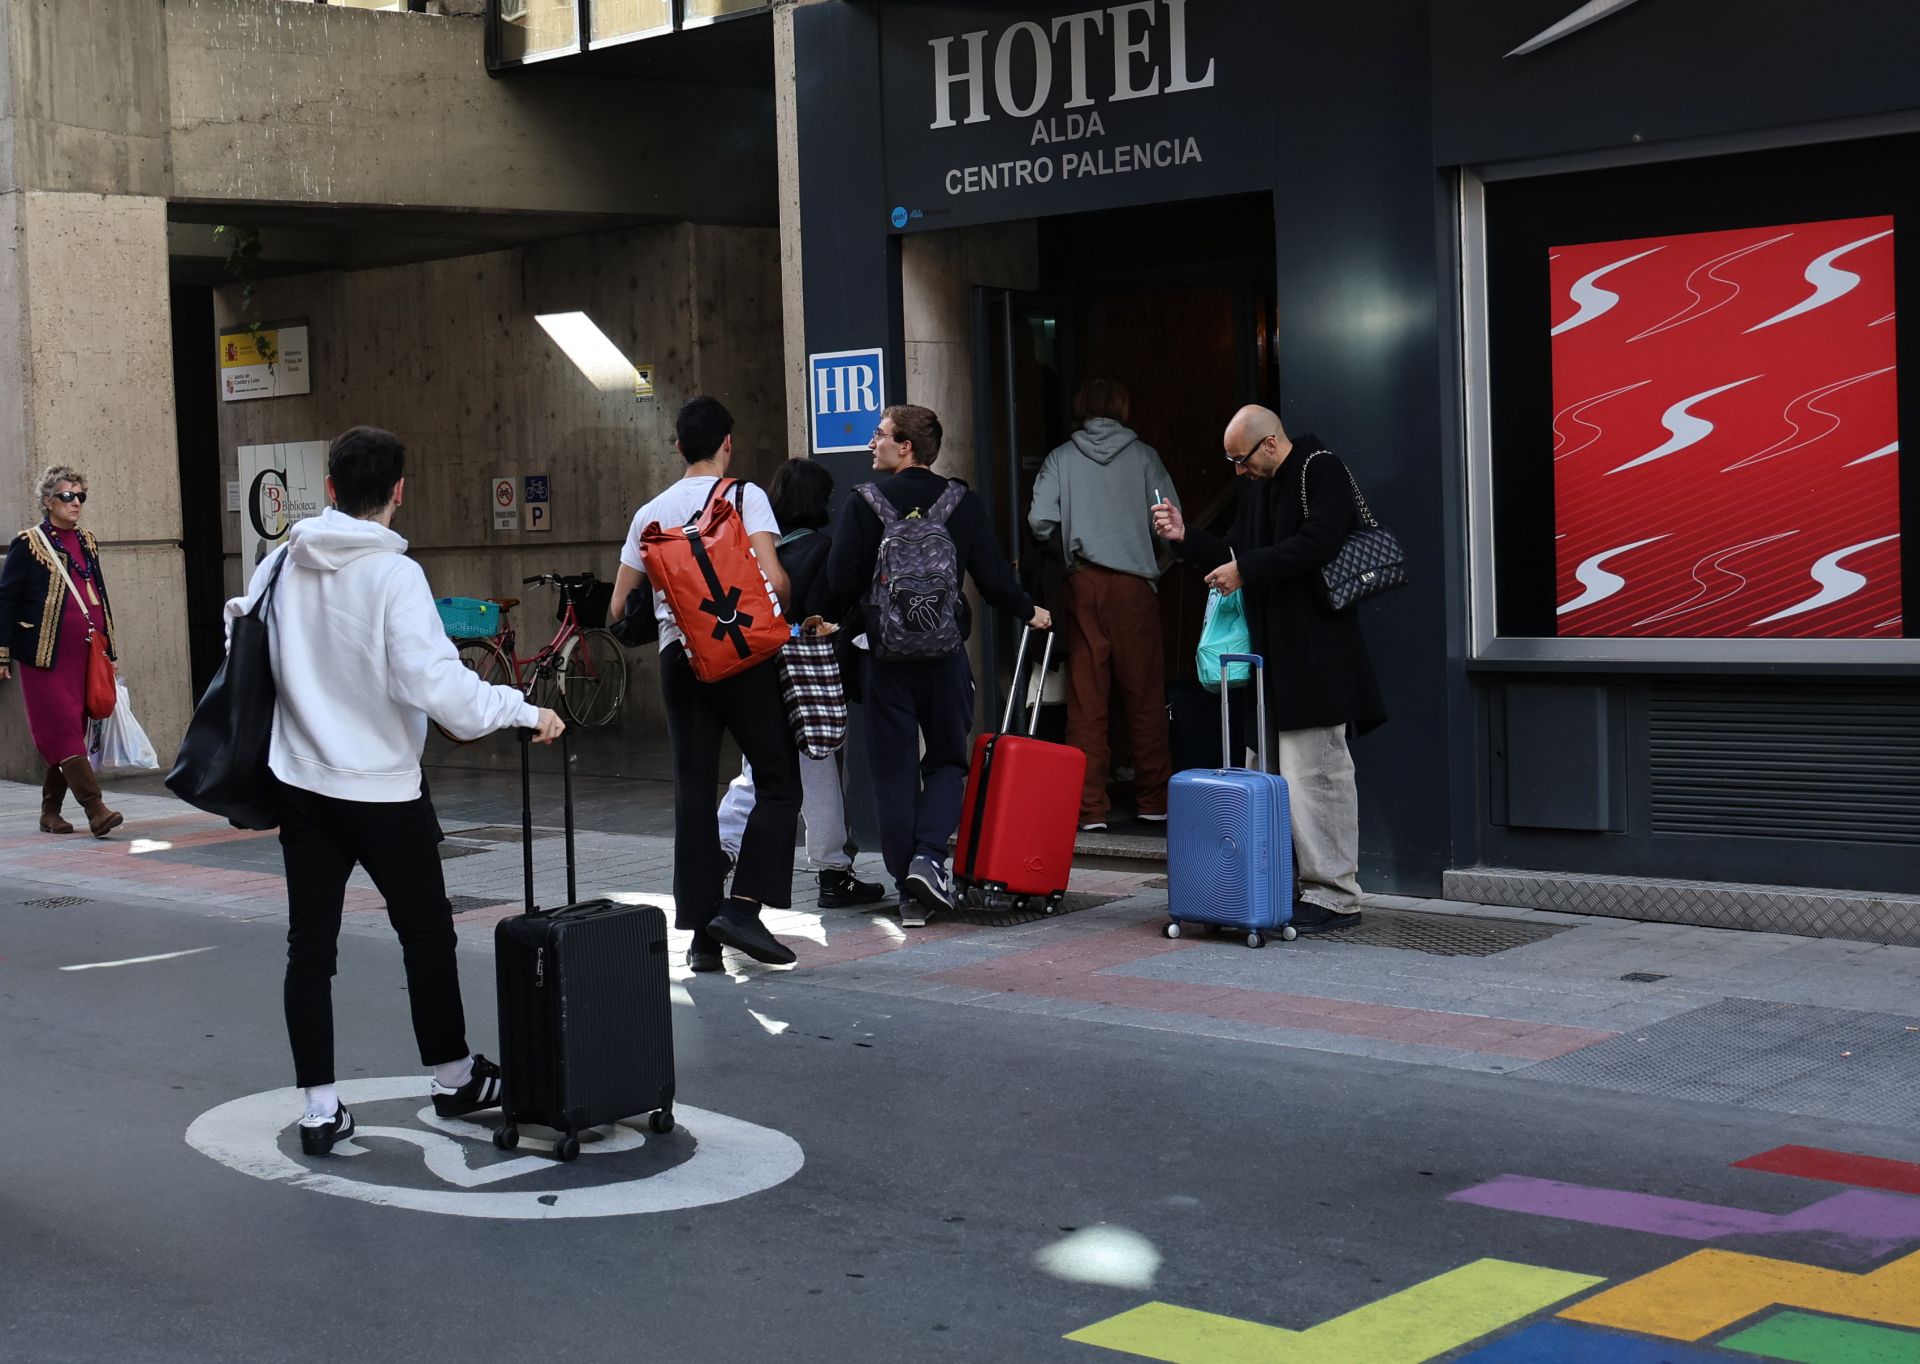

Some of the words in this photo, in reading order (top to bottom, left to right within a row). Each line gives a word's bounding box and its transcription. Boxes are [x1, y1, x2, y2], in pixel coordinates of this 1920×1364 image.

[928, 0, 1215, 129] HOTEL
[1030, 111, 1106, 146] ALDA
[945, 156, 1053, 195] CENTRO
[1062, 137, 1203, 180] PALENCIA
[816, 365, 880, 414] HR
[282, 500, 317, 512] Biblioteca
[532, 506, 543, 527] P
